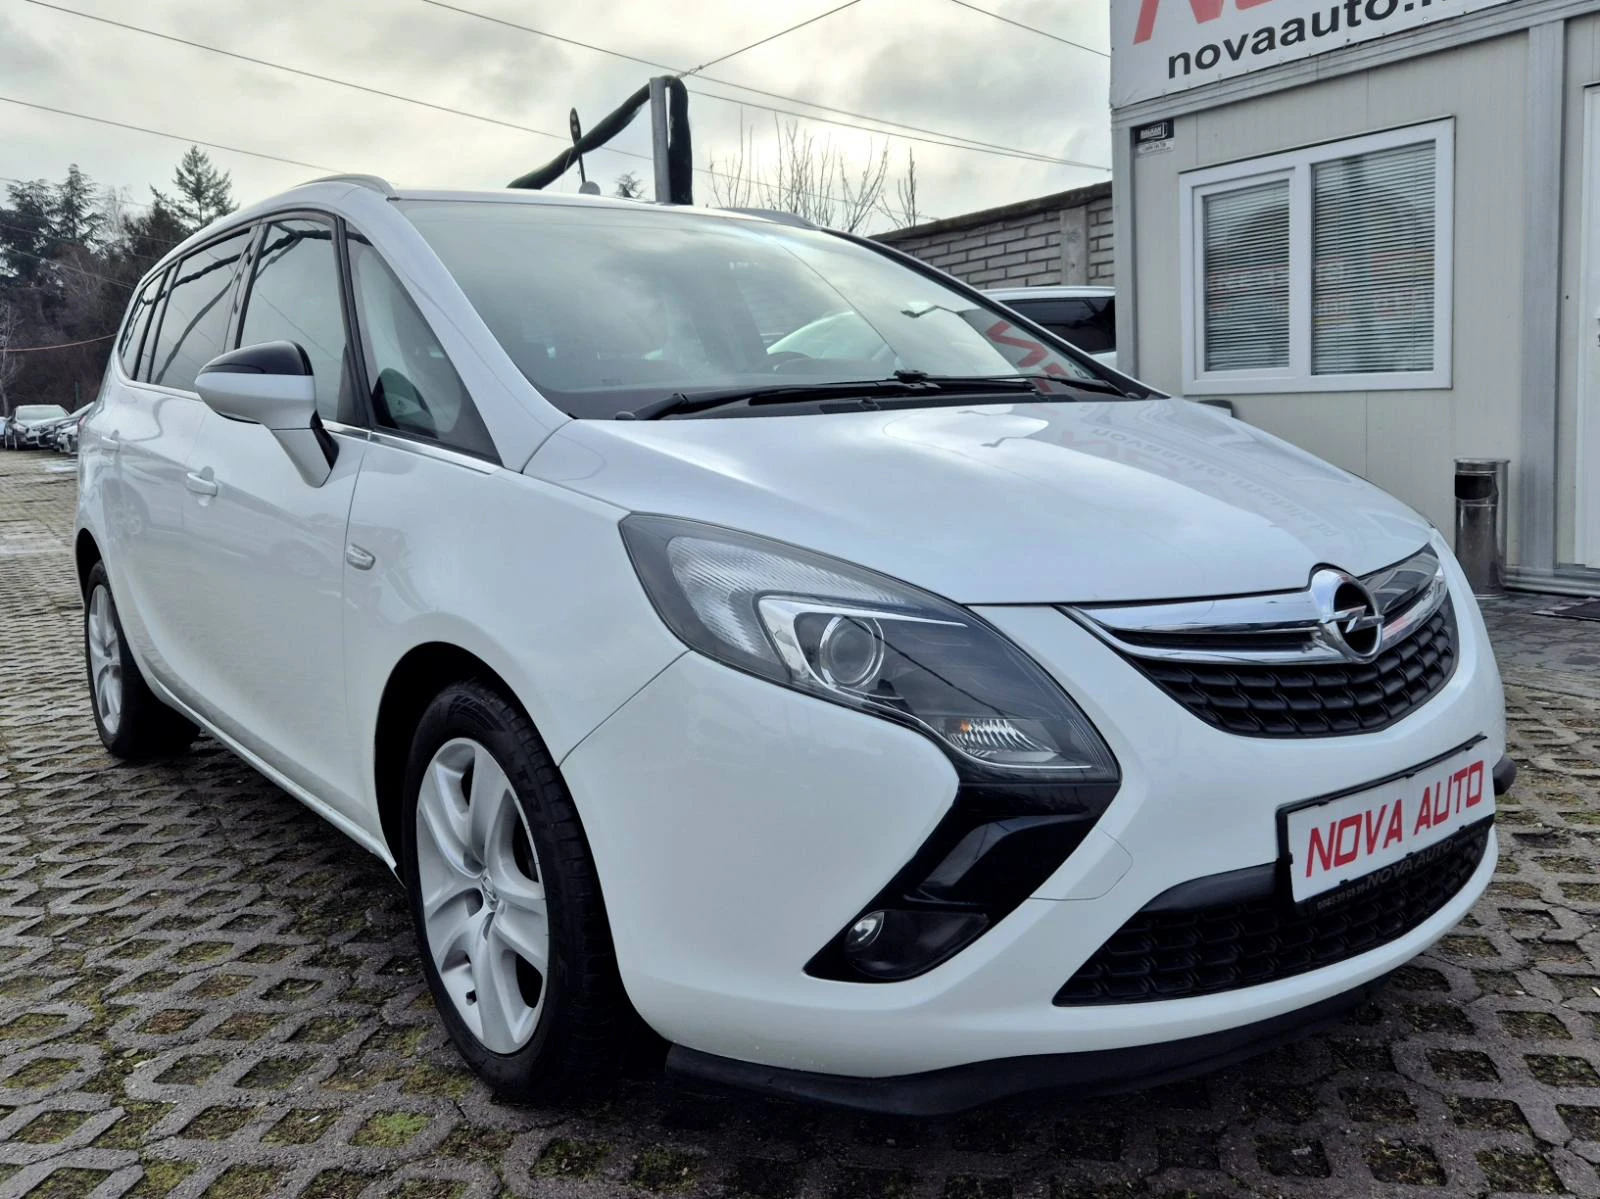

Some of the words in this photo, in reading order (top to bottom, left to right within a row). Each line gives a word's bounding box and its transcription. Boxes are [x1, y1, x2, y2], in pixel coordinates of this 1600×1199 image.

[1168, 0, 1447, 80] novaauto.
[1305, 799, 1403, 878] NOVA
[1413, 760, 1484, 836] AUTO
[1366, 859, 1413, 890] NOVA
[1414, 839, 1453, 868] AUTO
